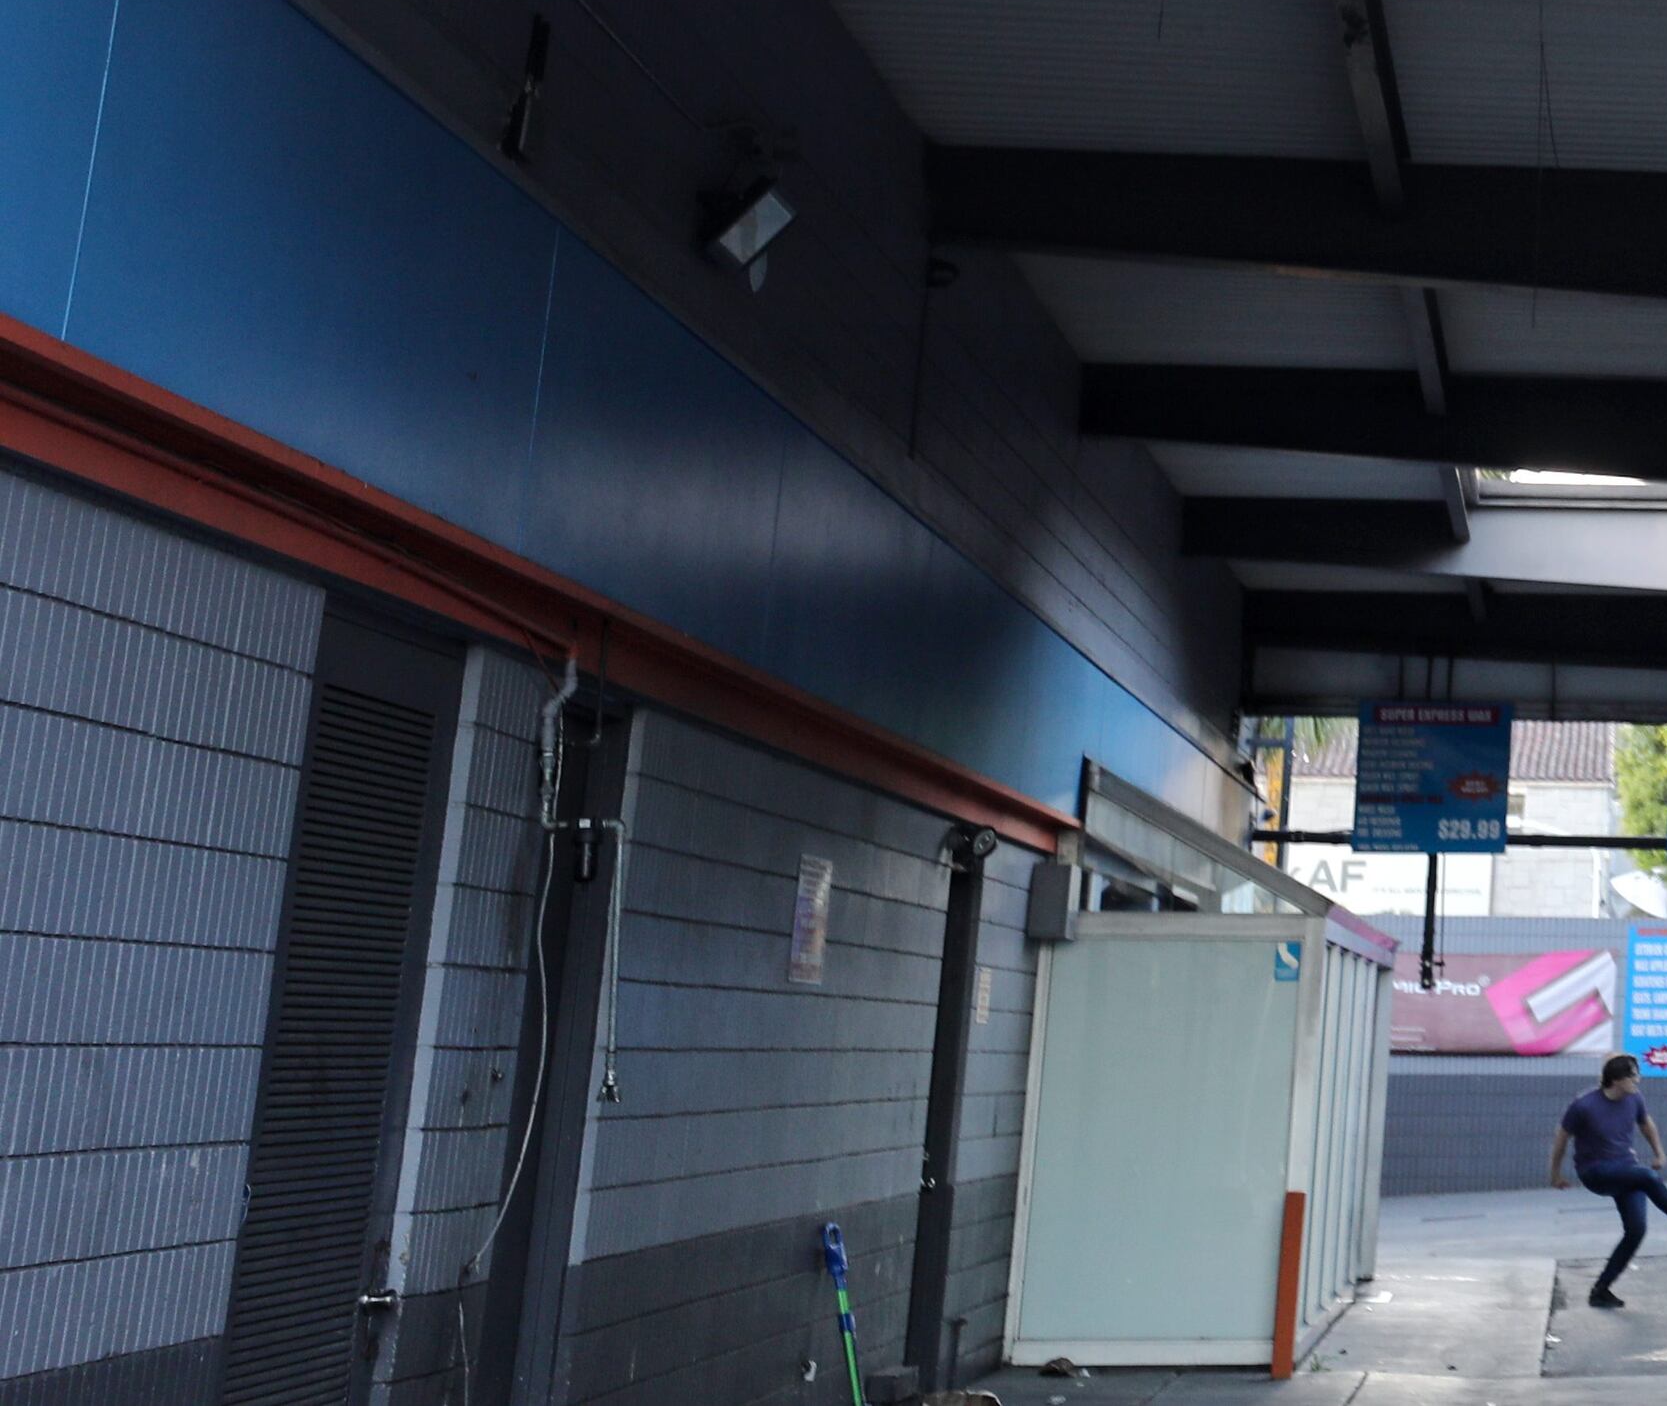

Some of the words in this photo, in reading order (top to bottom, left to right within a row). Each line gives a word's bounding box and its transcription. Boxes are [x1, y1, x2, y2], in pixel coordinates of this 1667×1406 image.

[1380, 708, 1415, 721] SUPER
[1418, 709, 1464, 722] EXPRESS
[1438, 818, 1501, 840] $29.99
